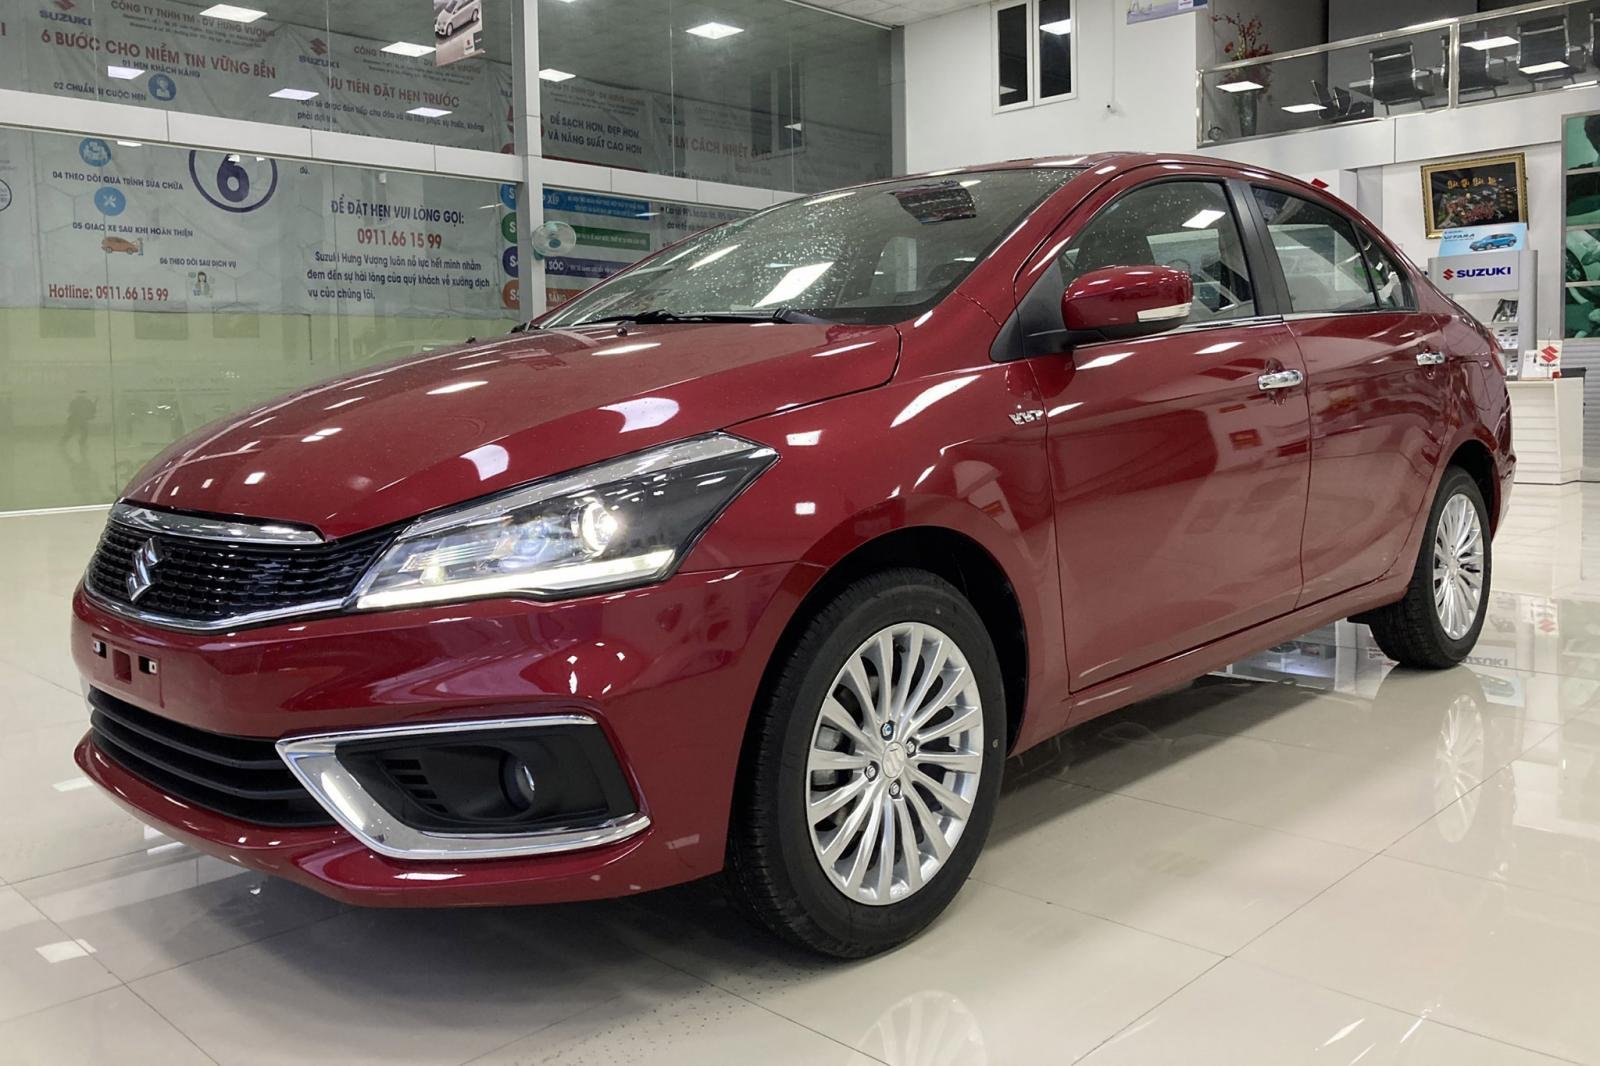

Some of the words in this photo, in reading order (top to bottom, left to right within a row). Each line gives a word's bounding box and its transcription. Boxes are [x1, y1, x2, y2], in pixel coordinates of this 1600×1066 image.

[39, 9, 92, 26] SUZUKI
[41, 29, 51, 43] 6
[55, 31, 100, 51] BƯỚC
[105, 40, 140, 58] CHO
[184, 53, 206, 68] TIN
[211, 55, 249, 75] VỮNG
[298, 54, 340, 69] SUZUKI
[346, 79, 370, 95] TIÊN
[399, 87, 420, 105] HẸN
[65, 172, 84, 181] THEO
[216, 153, 250, 203] 6
[331, 194, 345, 214] ĐỂ
[347, 200, 368, 219] ĐẶT
[370, 203, 391, 221] HẸN
[394, 206, 411, 220] VUI
[413, 205, 441, 223] LÒNG
[443, 210, 465, 227] GỌI:
[135, 226, 149, 235] KHI
[410, 232, 424, 248] 15
[427, 233, 442, 249] 99
[1456, 266, 1511, 278] SUZUKI
[48, 283, 93, 299] Hotline:
[95, 285, 138, 301] 0911.66
[141, 287, 154, 301] 15
[156, 287, 169, 301] 99
